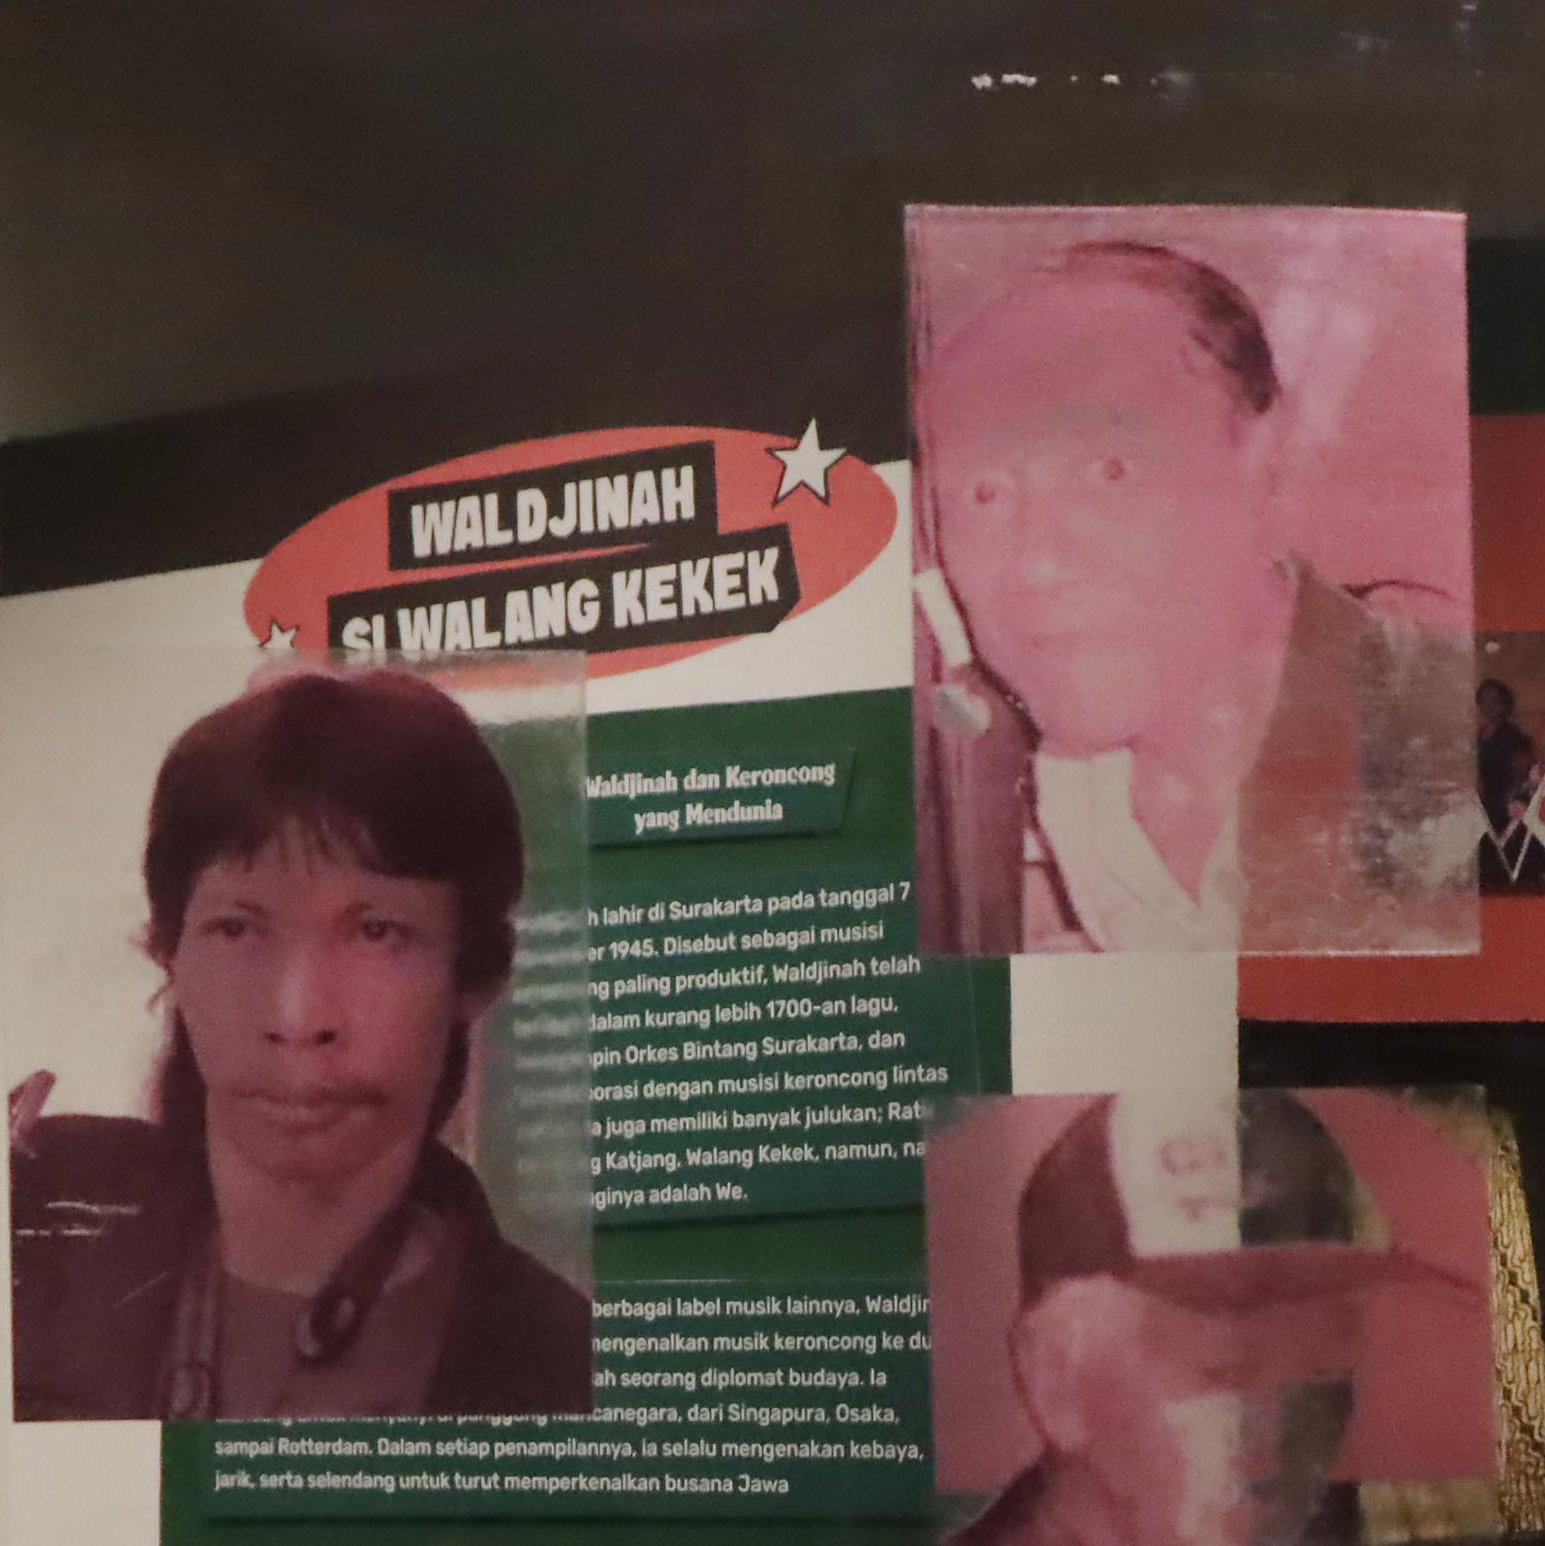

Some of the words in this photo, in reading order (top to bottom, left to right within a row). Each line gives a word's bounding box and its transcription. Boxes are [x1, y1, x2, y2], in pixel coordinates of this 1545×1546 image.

[410, 462, 696, 560] WALDJINAH
[397, 577, 601, 655] WALANG
[611, 546, 784, 631] KEKEK
[585, 767, 679, 800] Waldjinah
[683, 767, 721, 791] dan
[724, 761, 837, 790] Keroncong
[634, 805, 680, 835] yang
[685, 797, 784, 828] Mendunia
[603, 904, 645, 927] lahir
[647, 902, 666, 923] di
[669, 896, 764, 920] Surakarta
[767, 890, 816, 916] pada
[819, 882, 895, 910] tanggal
[899, 881, 912, 901] 7
[608, 937, 660, 960] 1945.
[663, 931, 737, 957] Disebut
[740, 924, 816, 953] sebagai
[820, 919, 885, 944] musisi
[613, 973, 671, 1000] paling
[674, 965, 770, 995] produktif,
[772, 957, 867, 985] Waldjinah
[869, 953, 922, 977] telah
[644, 1007, 712, 1031] kurang
[715, 1002, 762, 1023] lebih
[765, 997, 847, 1019] 1700-an
[625, 1041, 679, 1065] Orkes
[682, 1038, 758, 1063] Bintang
[761, 1031, 864, 1056] Surakarta,
[867, 1029, 906, 1050] dan
[642, 1077, 715, 1102] dengan
[717, 1072, 780, 1095] musisi
[783, 1065, 889, 1092] keroncong
[891, 1062, 950, 1085] lintas
[604, 1115, 647, 1140] juga
[650, 1109, 728, 1133] memiliki
[732, 1107, 801, 1132] banyak
[685, 1146, 754, 1171] Walang
[757, 1143, 821, 1164] Kekek,
[824, 1140, 898, 1161] namun,
[648, 1182, 712, 1204] adalah
[715, 1181, 749, 1202] We.
[591, 1297, 672, 1322] berbagai
[676, 1296, 722, 1318] label
[725, 1295, 783, 1317] musik
[713, 1331, 771, 1353] musik
[773, 1331, 878, 1356] keroncong
[881, 1330, 906, 1350] ke
[620, 1370, 697, 1392] seorang
[700, 1366, 786, 1392] diplomat
[788, 1367, 865, 1392] budaya.
[869, 1368, 888, 1388] Ia
[687, 1403, 725, 1423] dari
[728, 1403, 832, 1427] Singapura,
[835, 1403, 902, 1425] Osaka,
[214, 1438, 275, 1458] sampai
[277, 1437, 374, 1457] Rotterdam.
[377, 1436, 432, 1458] Dalam
[435, 1438, 491, 1460] setiap
[661, 1437, 717, 1458] selalu
[721, 1438, 846, 1464] mengenakan
[849, 1439, 925, 1463] kebaya,
[259, 1470, 304, 1489] serta
[307, 1470, 396, 1493] selendang
[399, 1471, 450, 1489] untuk
[454, 1471, 501, 1489] turut
[504, 1471, 661, 1495] memperkenalkan
[664, 1473, 734, 1494] busana
[738, 1473, 791, 1495] Jawa
